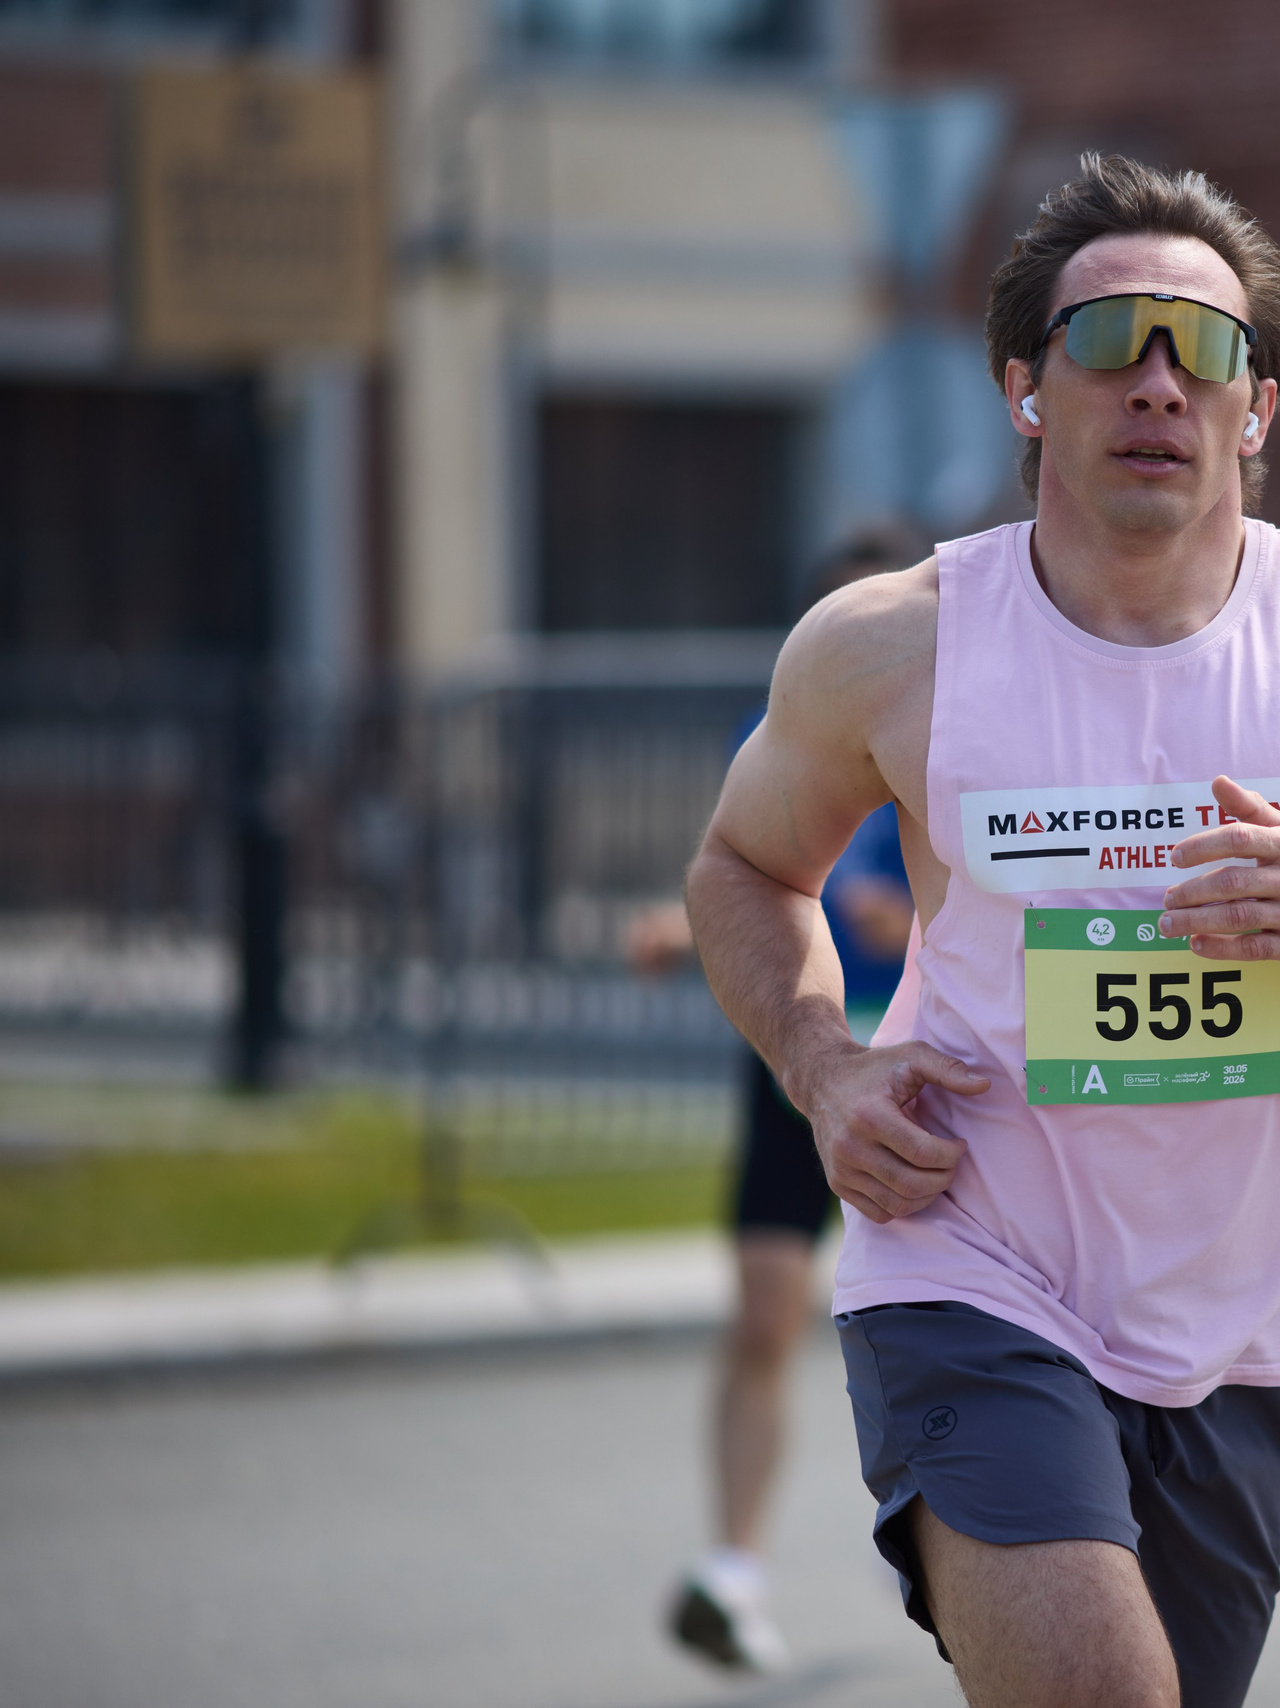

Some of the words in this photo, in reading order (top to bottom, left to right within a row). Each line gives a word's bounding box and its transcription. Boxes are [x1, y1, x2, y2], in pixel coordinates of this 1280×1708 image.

[988, 807, 1186, 836] MAXFORCE
[1092, 923, 1110, 936] 4,2
[1095, 970, 1243, 1041] 555
[1081, 1065, 1108, 1094] A
[1223, 1064, 1248, 1075] 30.05
[1223, 1075, 1245, 1085] 2026
